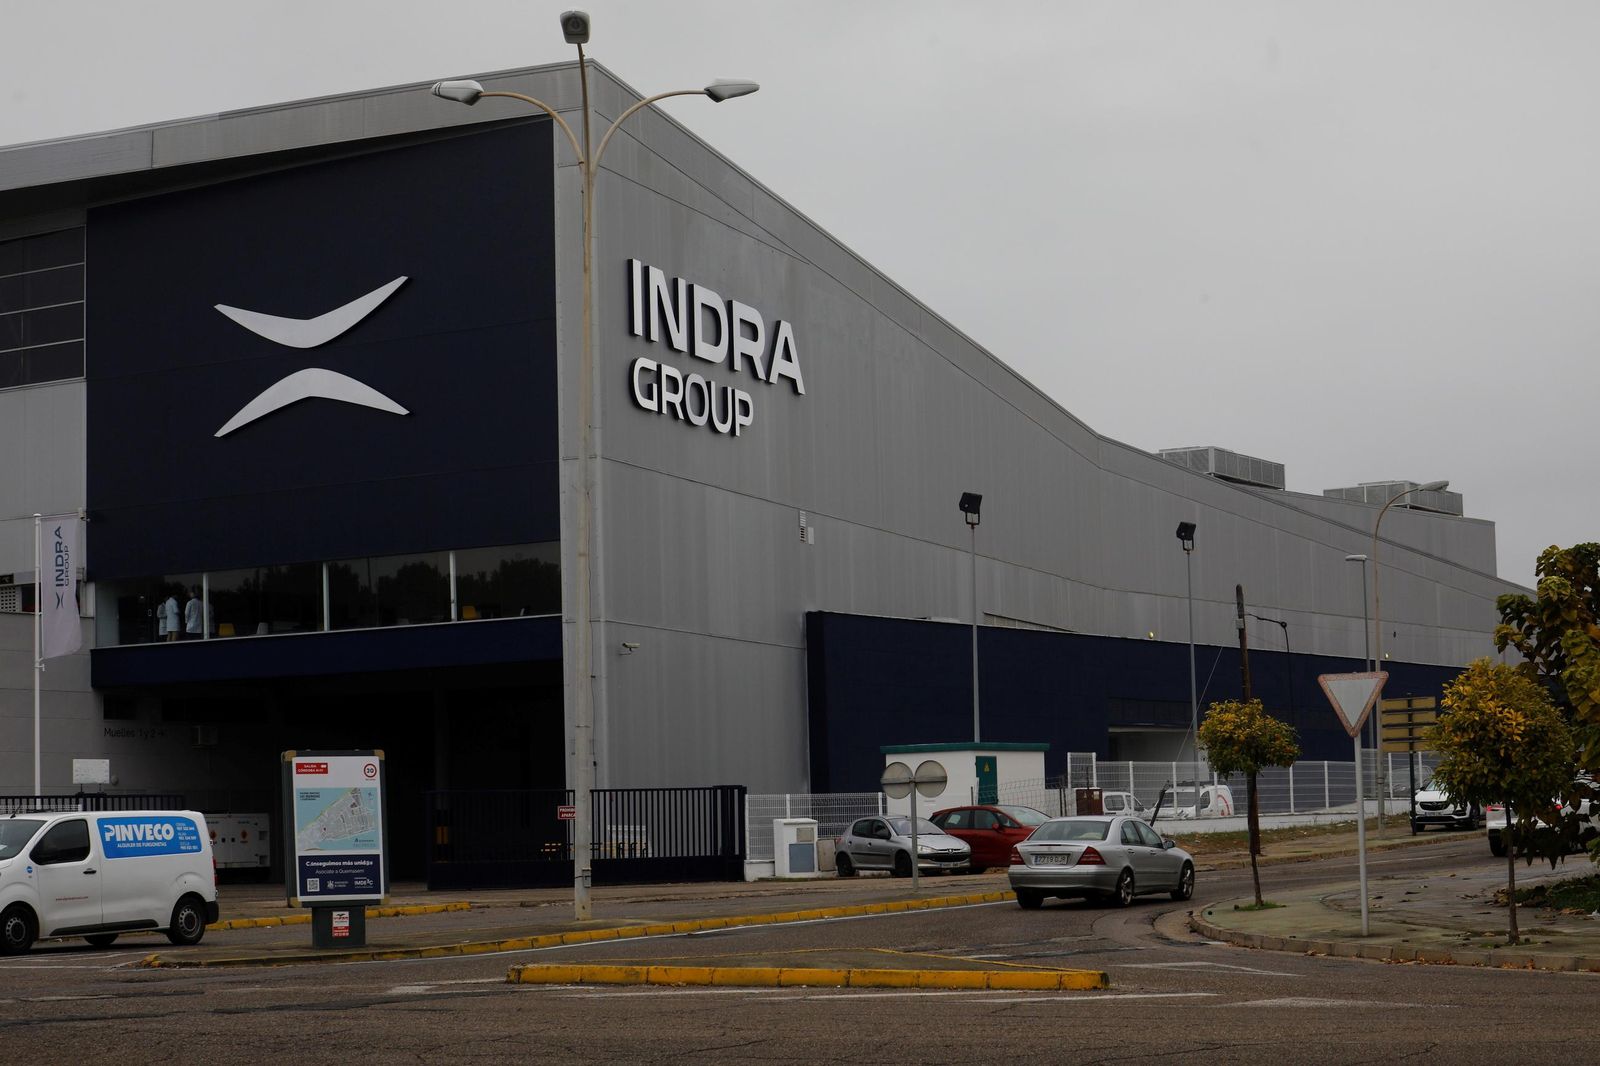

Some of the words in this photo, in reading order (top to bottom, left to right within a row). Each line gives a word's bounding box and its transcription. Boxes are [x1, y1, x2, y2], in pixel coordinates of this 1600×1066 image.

[628, 258, 806, 396] INDRA
[631, 357, 754, 437] GROUP
[54, 526, 64, 587] INDRA
[104, 823, 175, 842] PINVECO
